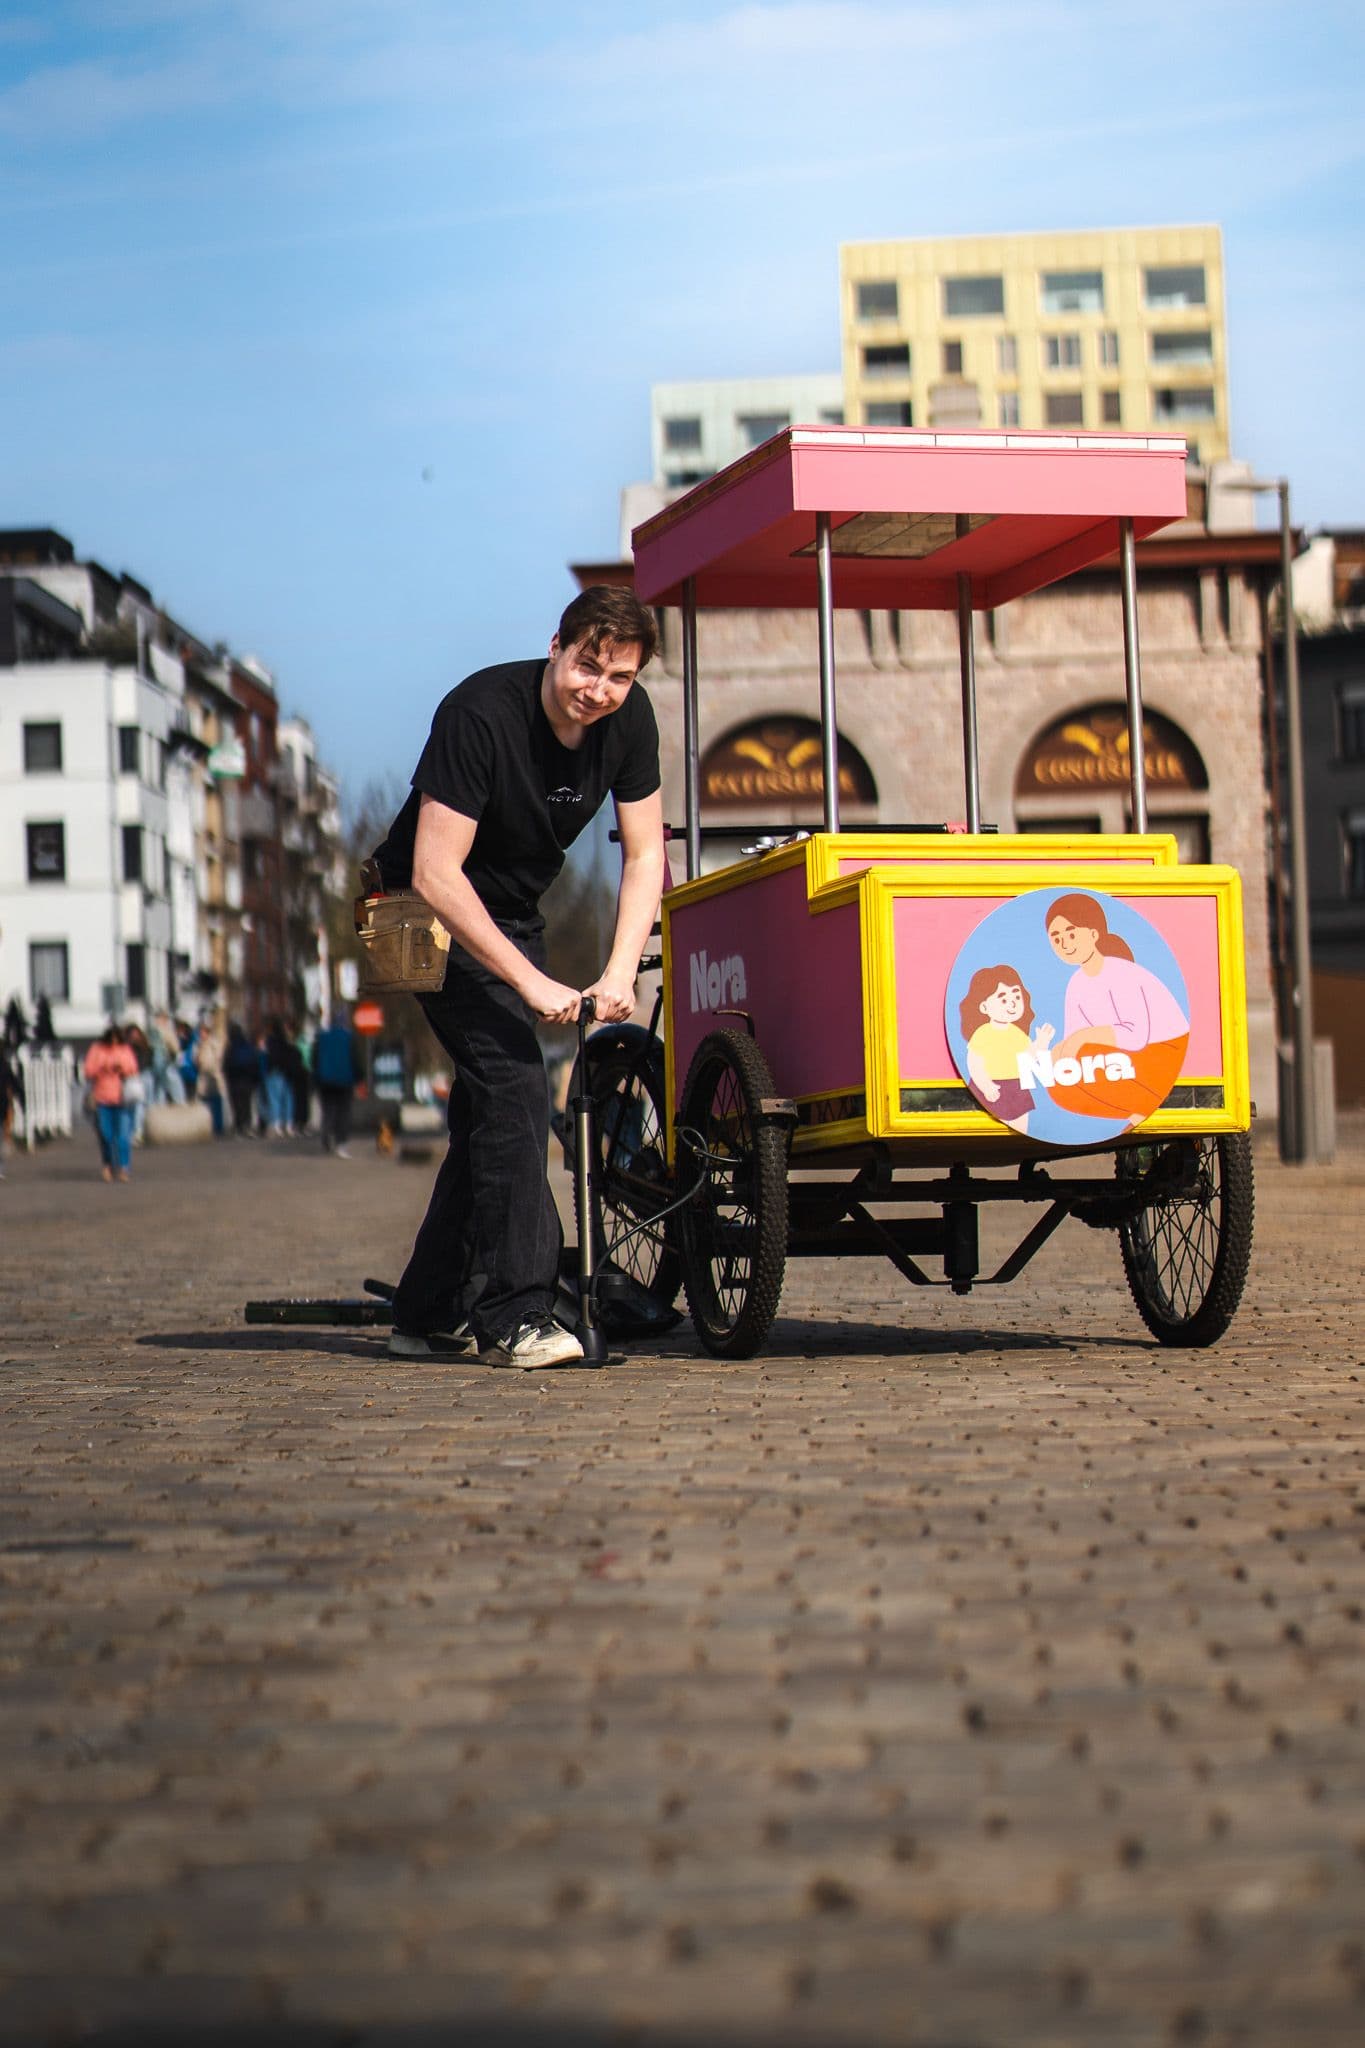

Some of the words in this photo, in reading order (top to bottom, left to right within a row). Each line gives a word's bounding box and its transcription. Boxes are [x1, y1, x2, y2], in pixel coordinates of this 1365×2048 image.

[707, 767, 853, 796] PATISSERE
[690, 950, 746, 1013] Nora
[1016, 1050, 1136, 1090] Nora
